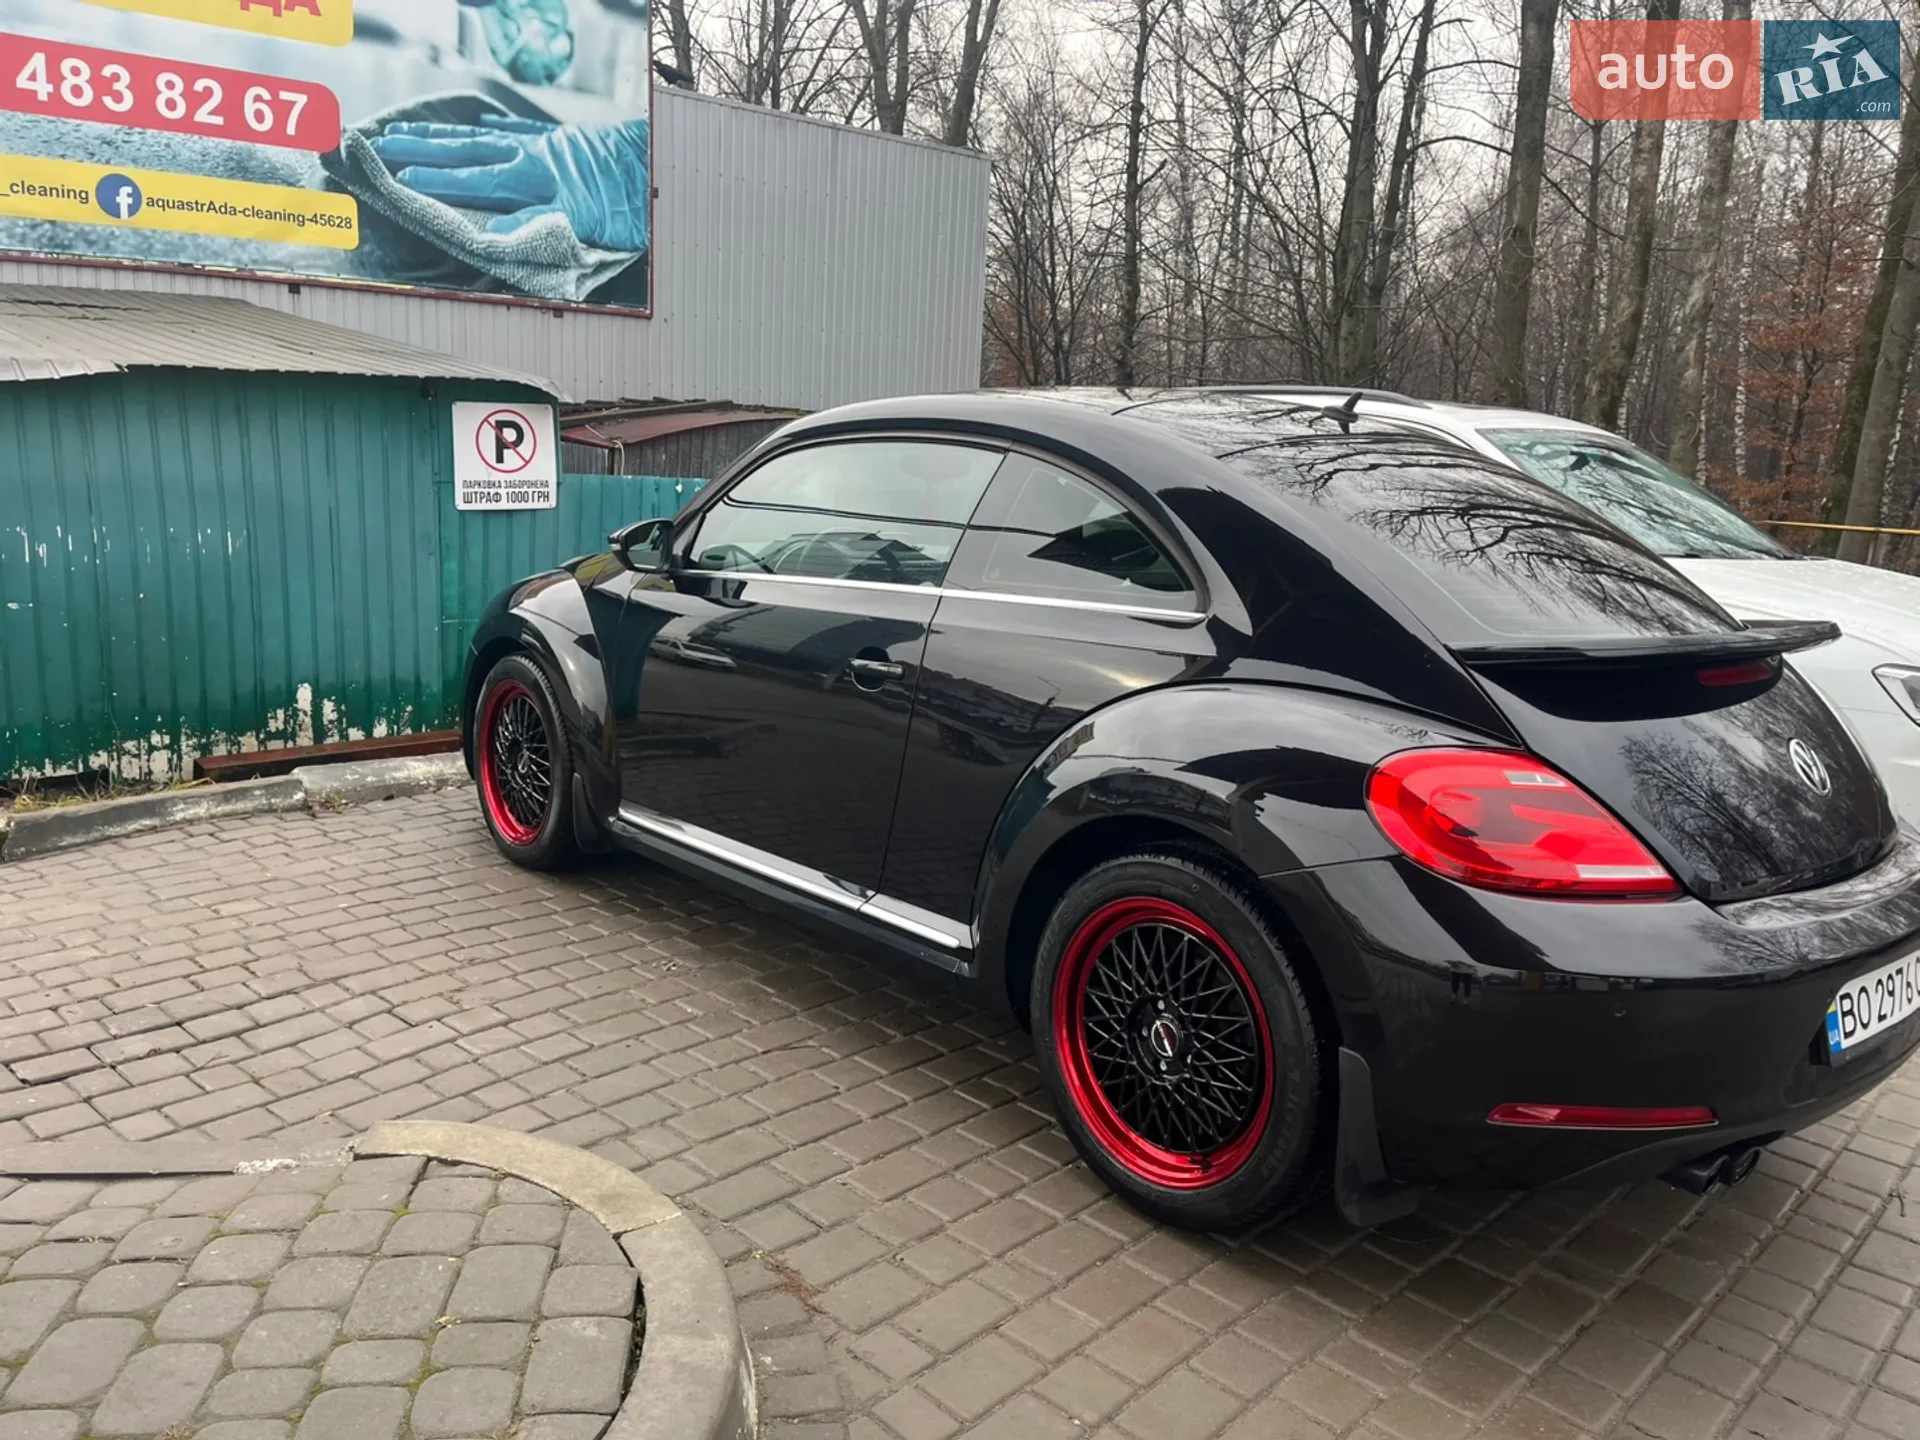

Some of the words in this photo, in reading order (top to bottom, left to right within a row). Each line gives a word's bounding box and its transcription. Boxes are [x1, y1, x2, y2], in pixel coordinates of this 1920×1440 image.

[15, 52, 134, 112] 483
[155, 72, 224, 125] 82
[243, 86, 308, 136] 67
[146, 196, 352, 229] aquastrAda-cleaning-45628
[462, 480, 502, 489] ПАРКОВКА
[504, 480, 549, 489] ЗАБОРОНЕНА
[463, 491, 502, 504] ШТРАФ
[506, 491, 529, 503] 1000
[531, 490, 550, 503] ГРН
[1839, 985, 1871, 1040] BO
[1875, 962, 1913, 1024] 2976
